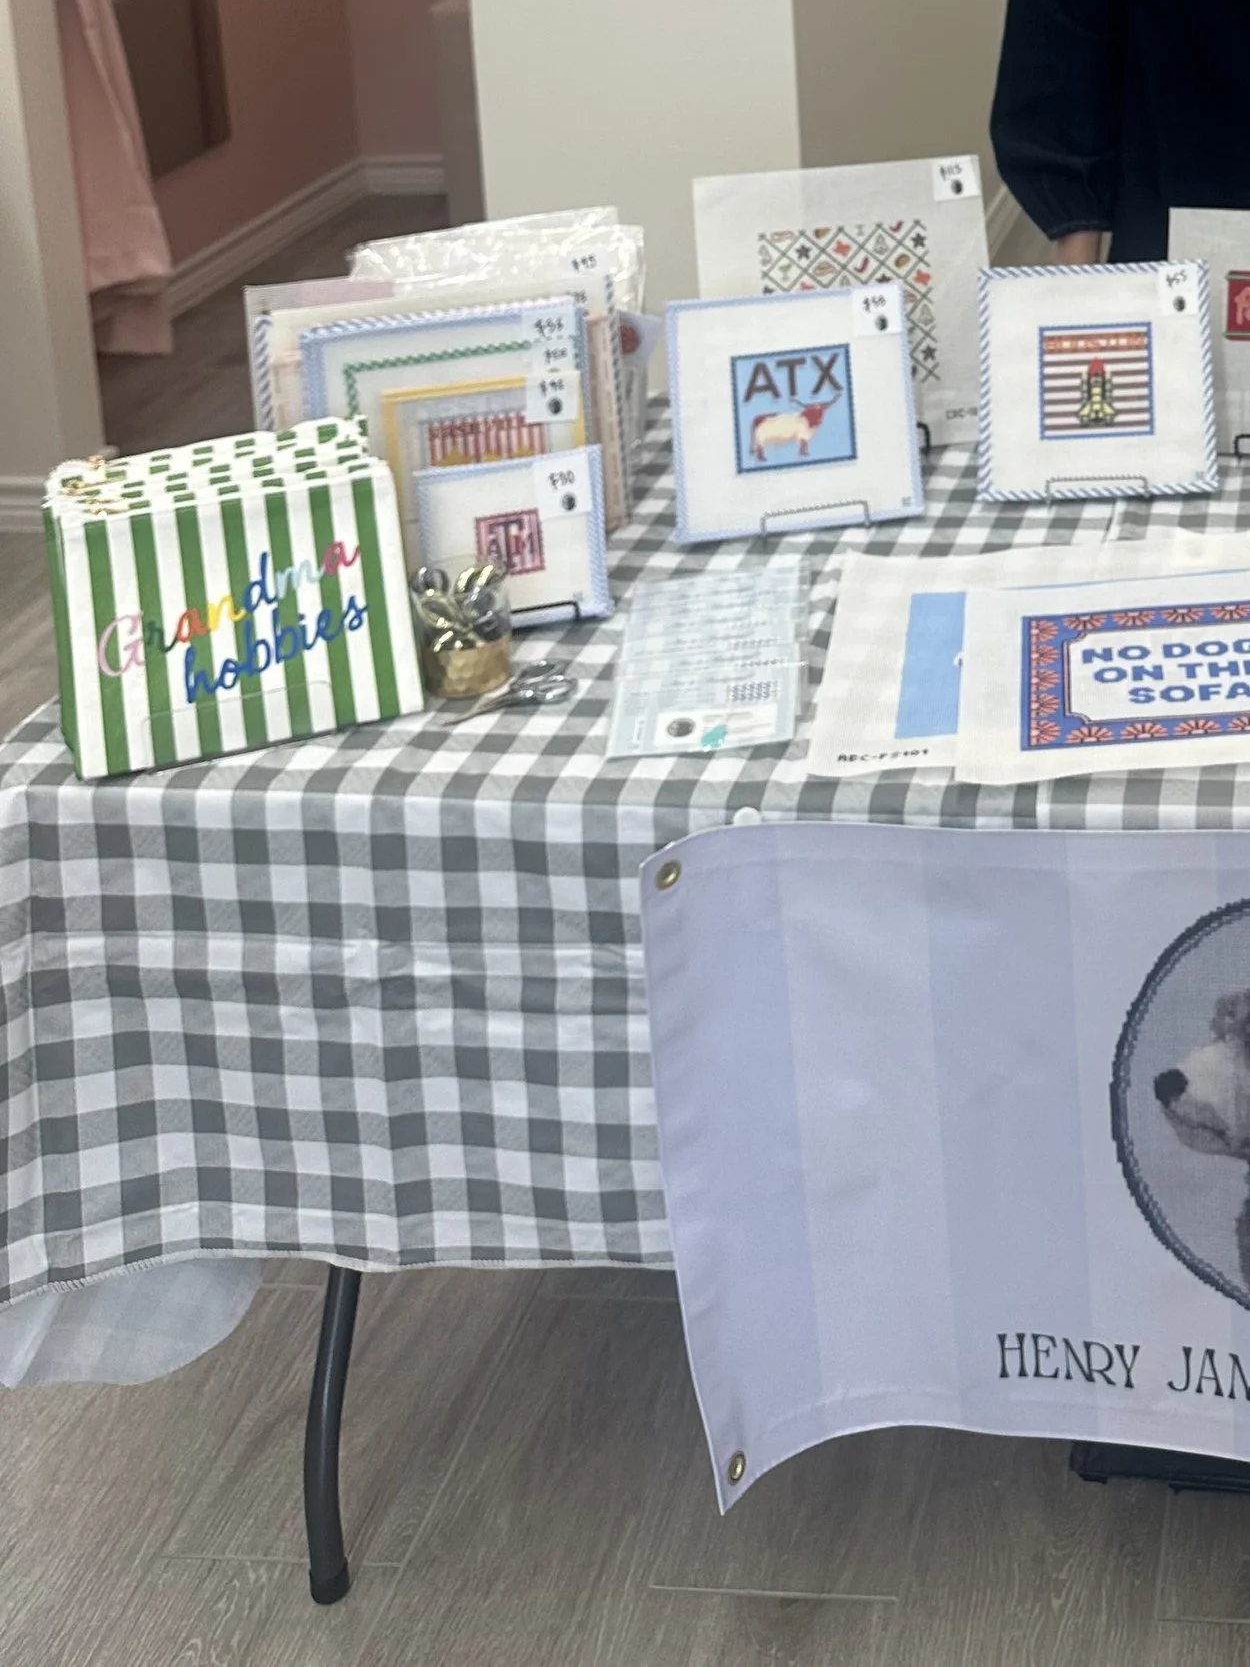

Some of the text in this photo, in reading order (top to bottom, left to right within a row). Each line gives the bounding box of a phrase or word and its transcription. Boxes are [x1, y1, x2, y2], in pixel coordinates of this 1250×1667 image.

[742, 352, 844, 403] ATX
[98, 539, 361, 677] Grandma
[183, 594, 369, 704] hobbies
[1081, 645, 1151, 664] NO
[1093, 664, 1164, 684] ON
[996, 1332, 1141, 1389] HENRY
